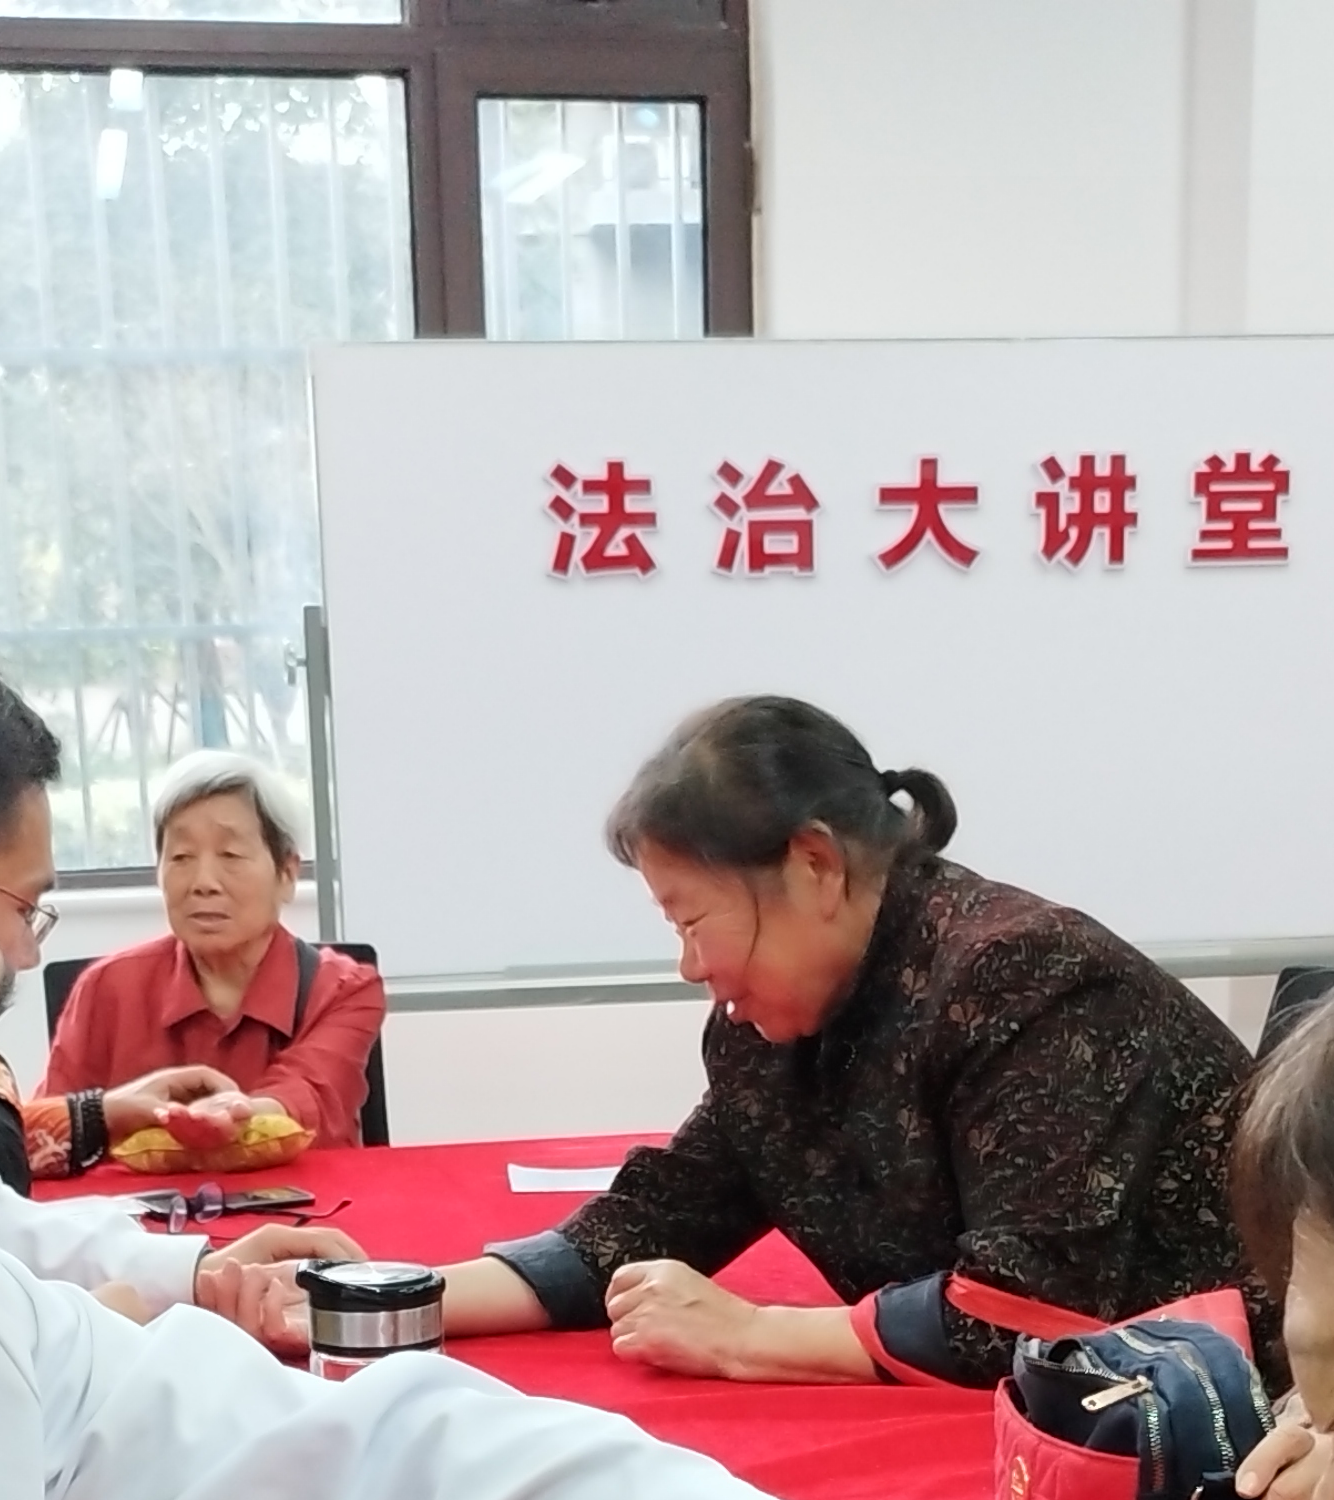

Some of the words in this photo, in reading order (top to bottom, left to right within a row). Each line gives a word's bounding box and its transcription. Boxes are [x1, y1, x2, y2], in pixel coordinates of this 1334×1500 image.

[546, 451, 1292, 578] 法治大讲堂
